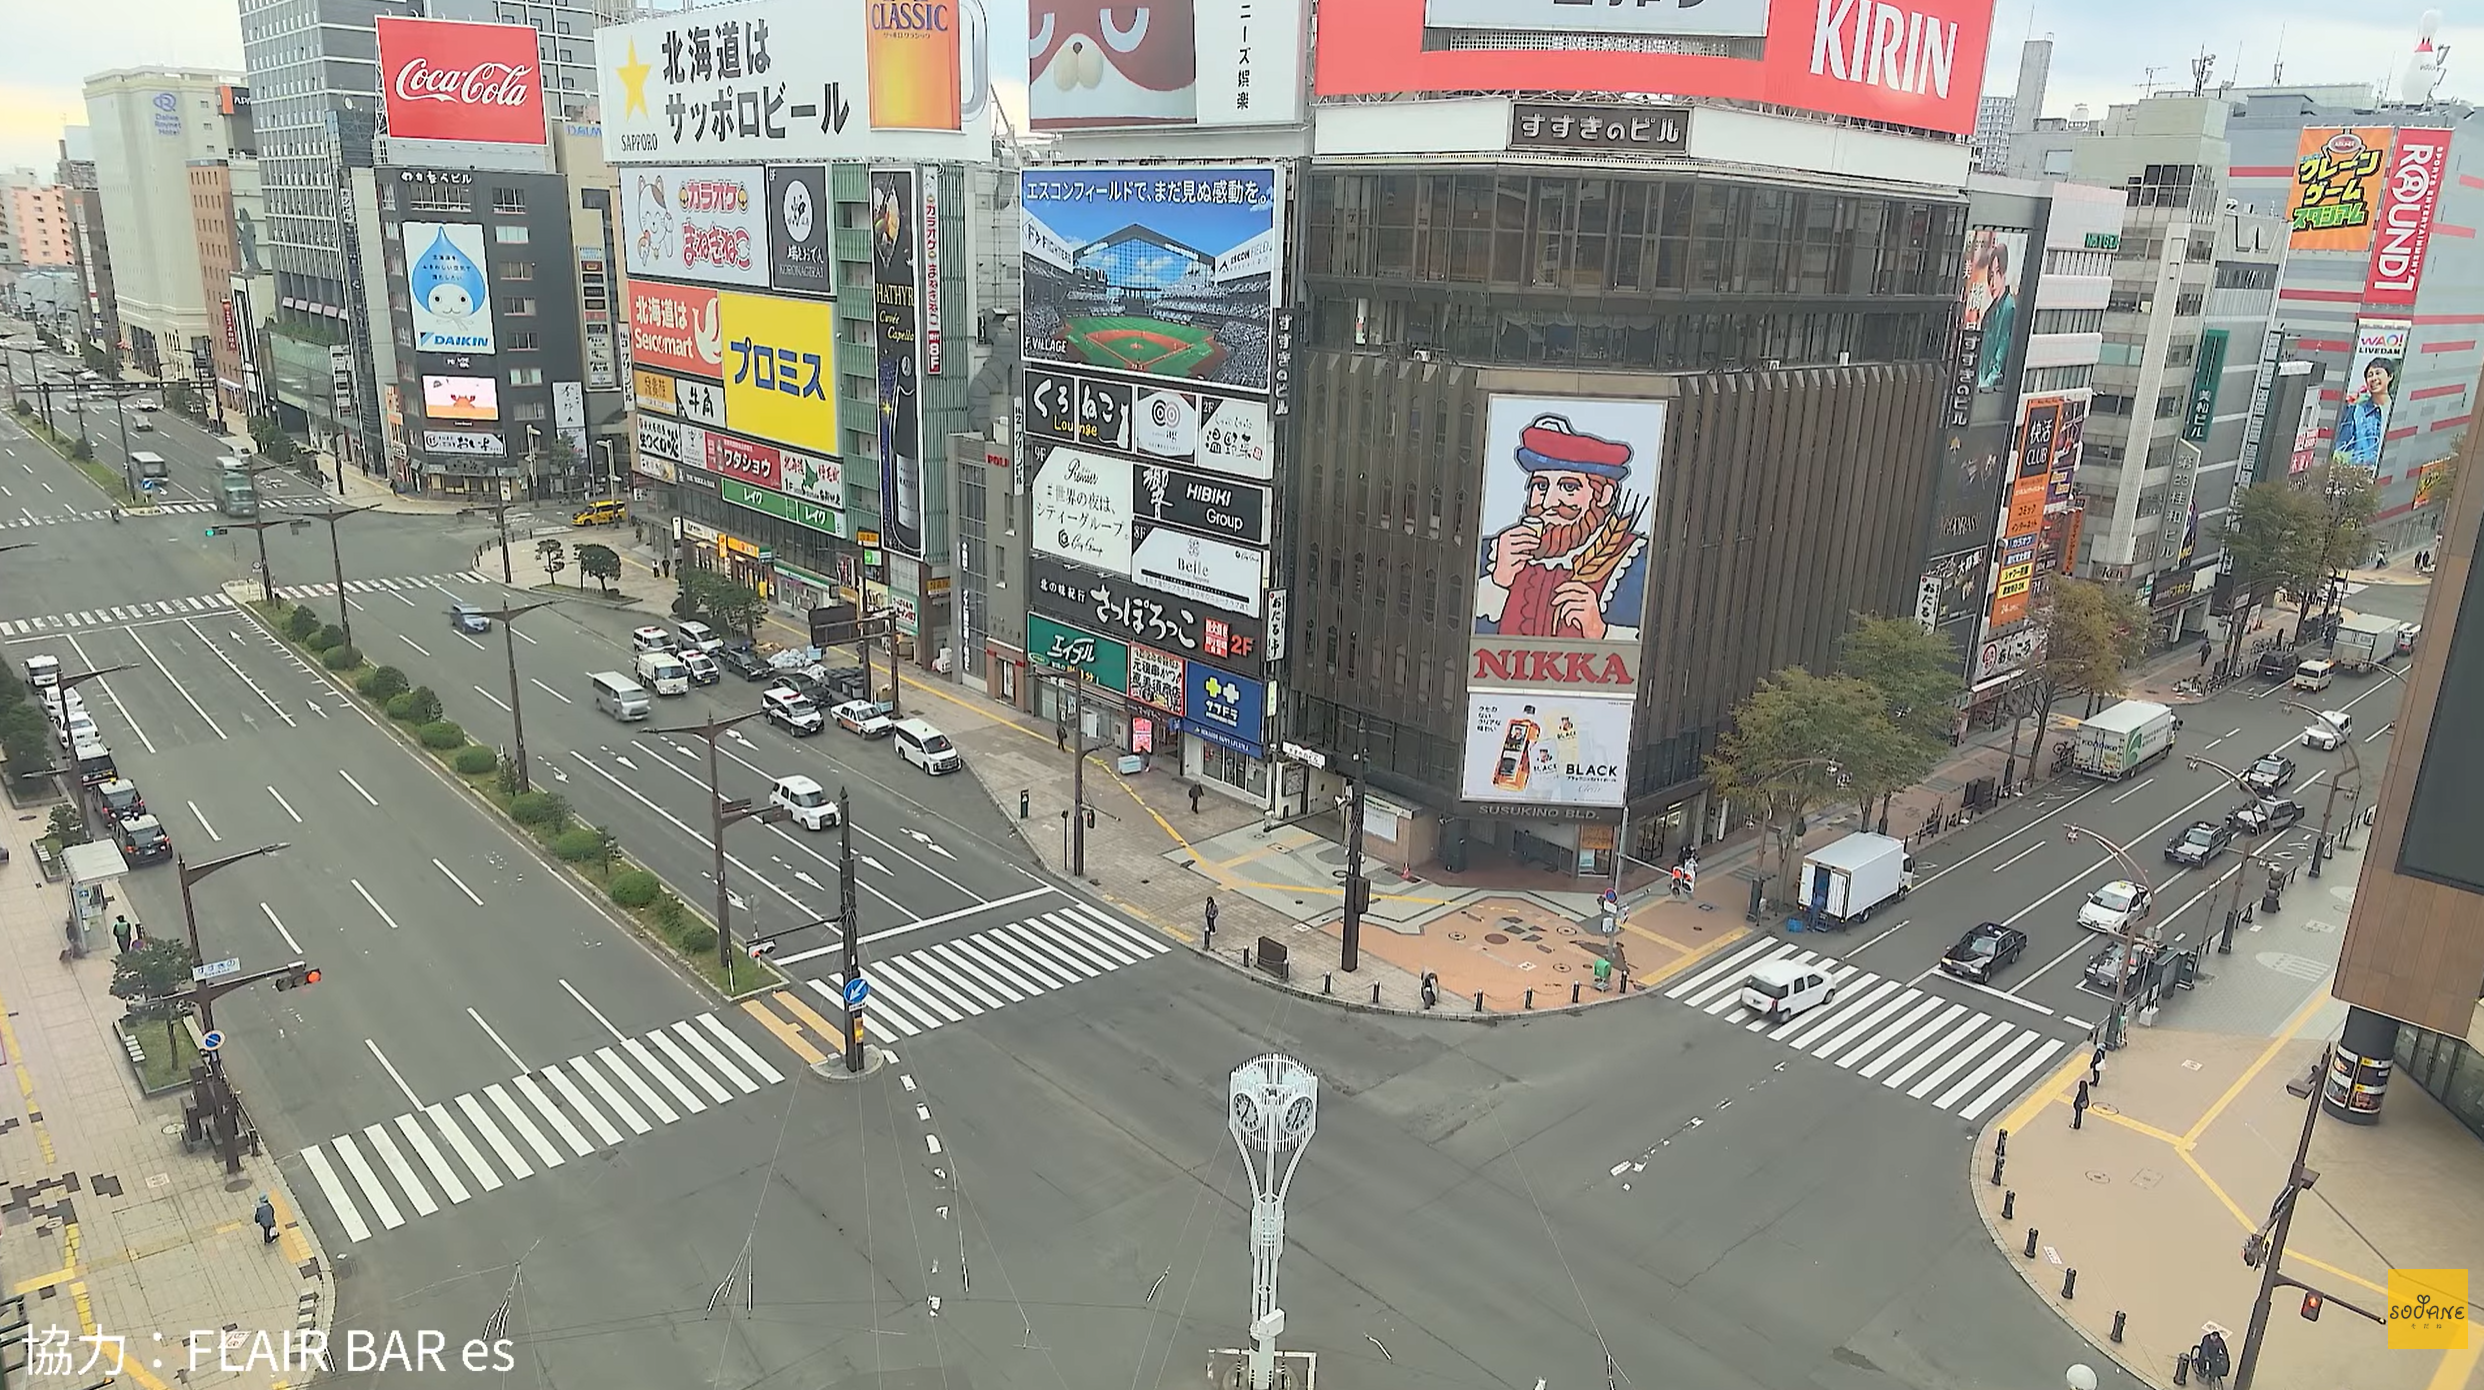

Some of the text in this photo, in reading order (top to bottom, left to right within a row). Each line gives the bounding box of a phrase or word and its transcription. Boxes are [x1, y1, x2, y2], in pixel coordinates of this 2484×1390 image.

[872, 2, 948, 31] CLASSIC
[661, 18, 771, 85] 北海道は
[1809, 0, 1958, 99] KIRIN
[395, 57, 532, 107] Coca-Cola
[665, 82, 850, 144] サッポロビール
[621, 133, 658, 151] SAPPORO
[1521, 113, 1680, 144] すすきのビル
[2300, 152, 2380, 182] クレーン
[688, 180, 739, 212] カラオケ
[1027, 179, 1267, 205] エスコンフィールドで、まだ見ぬ感動を。
[2304, 179, 2361, 206] ゲーム
[926, 205, 937, 250] カラオケ
[2293, 202, 2365, 230] スタジアム
[682, 220, 752, 268] まねきねこ
[636, 297, 687, 330] 北海道は
[435, 336, 488, 346] DAIKIN
[635, 328, 693, 358] Seicomart
[2361, 334, 2403, 347] WAO!
[731, 337, 825, 401] プロミス
[929, 343, 939, 372] 8F
[1203, 402, 1214, 413] 2F
[1054, 416, 1098, 437] Lounge
[2030, 420, 2052, 445] 快活
[725, 449, 771, 477] ワタショウ
[1034, 445, 1047, 462] 9F
[2026, 448, 2047, 466] CLUB
[744, 488, 763, 504] レイク
[1186, 482, 1232, 505] HIBIKI
[805, 506, 826, 525] レイク
[1206, 508, 1243, 530] Group
[1133, 526, 1146, 539] 8F
[1090, 584, 1196, 649] さっぽろっこ
[1047, 634, 1095, 665] エイブル
[1231, 634, 1254, 657] 2F
[1474, 648, 1635, 685] NIKKA
[1566, 764, 1617, 776] BLACK
[1479, 805, 1600, 820] SUSUKINO BLD.
